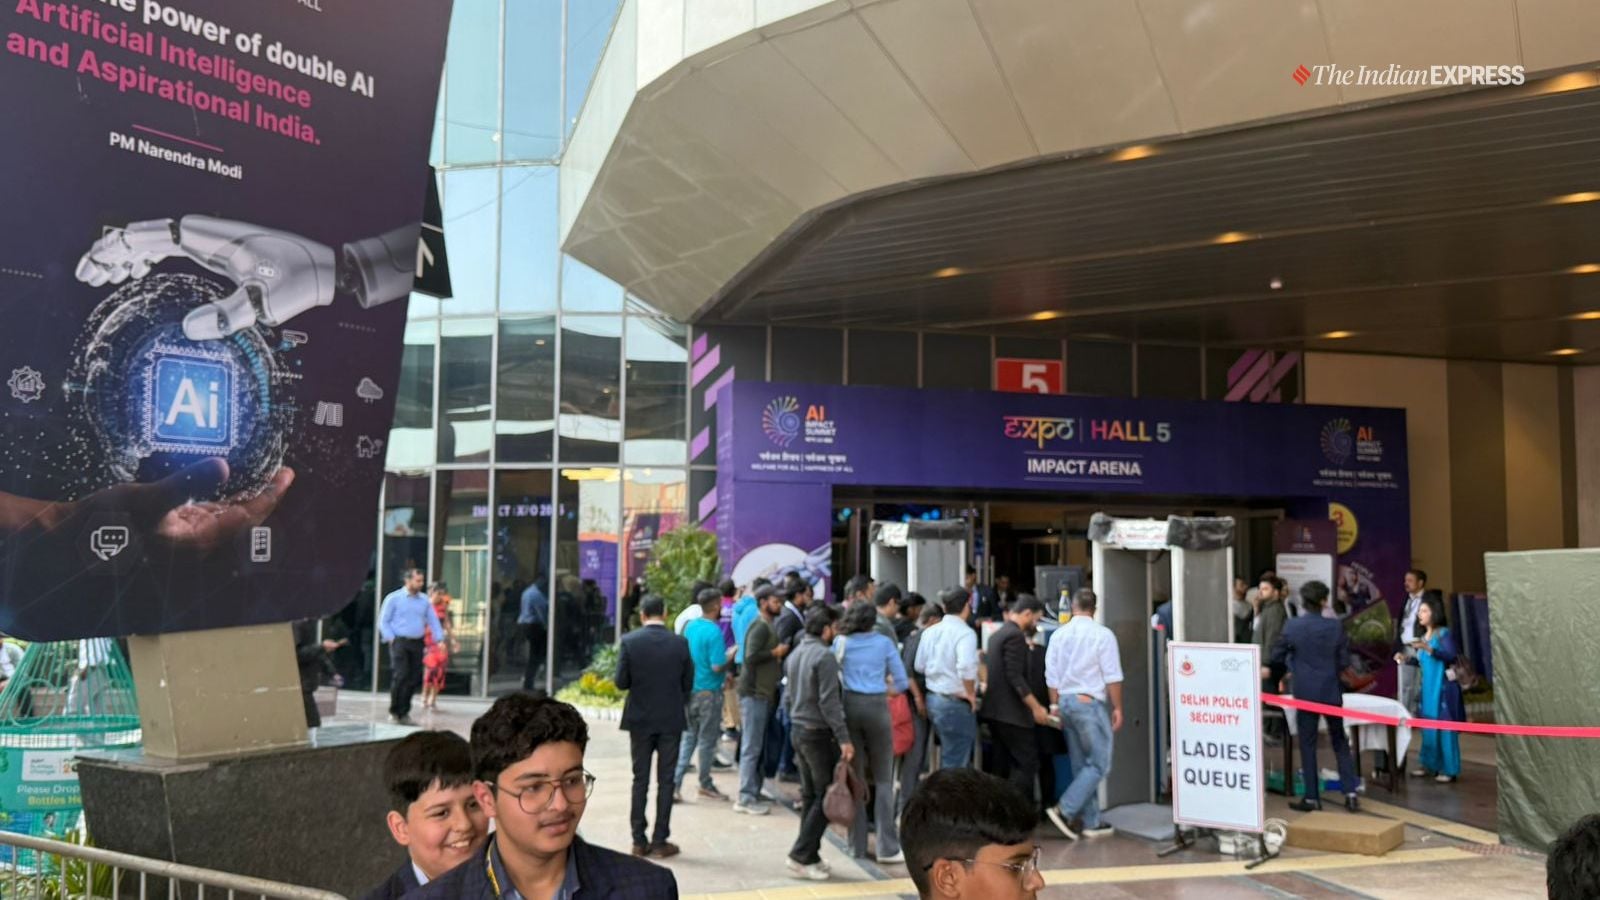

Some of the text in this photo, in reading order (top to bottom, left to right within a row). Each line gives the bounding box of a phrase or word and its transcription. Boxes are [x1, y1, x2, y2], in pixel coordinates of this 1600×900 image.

[15, 0, 312, 108] Artificial Intelligence
[143, 0, 375, 98] power of double AI
[6, 31, 320, 145] and Aspirational India.
[109, 131, 243, 180] PM Narendra Modi
[1021, 363, 1049, 395] 5
[165, 377, 219, 429] Ai
[805, 405, 824, 421] AI
[1091, 419, 1152, 442] HALL
[1156, 422, 1171, 443] 5
[1356, 426, 1373, 441] AI
[1027, 457, 1143, 477] IMPACT ARENA
[1180, 693, 1249, 709] DELHI POLICE
[1190, 711, 1240, 726] SECURITY
[1182, 739, 1251, 762] LADIES
[17, 784, 81, 796] Please Drop
[1184, 768, 1251, 791] QUEUE
